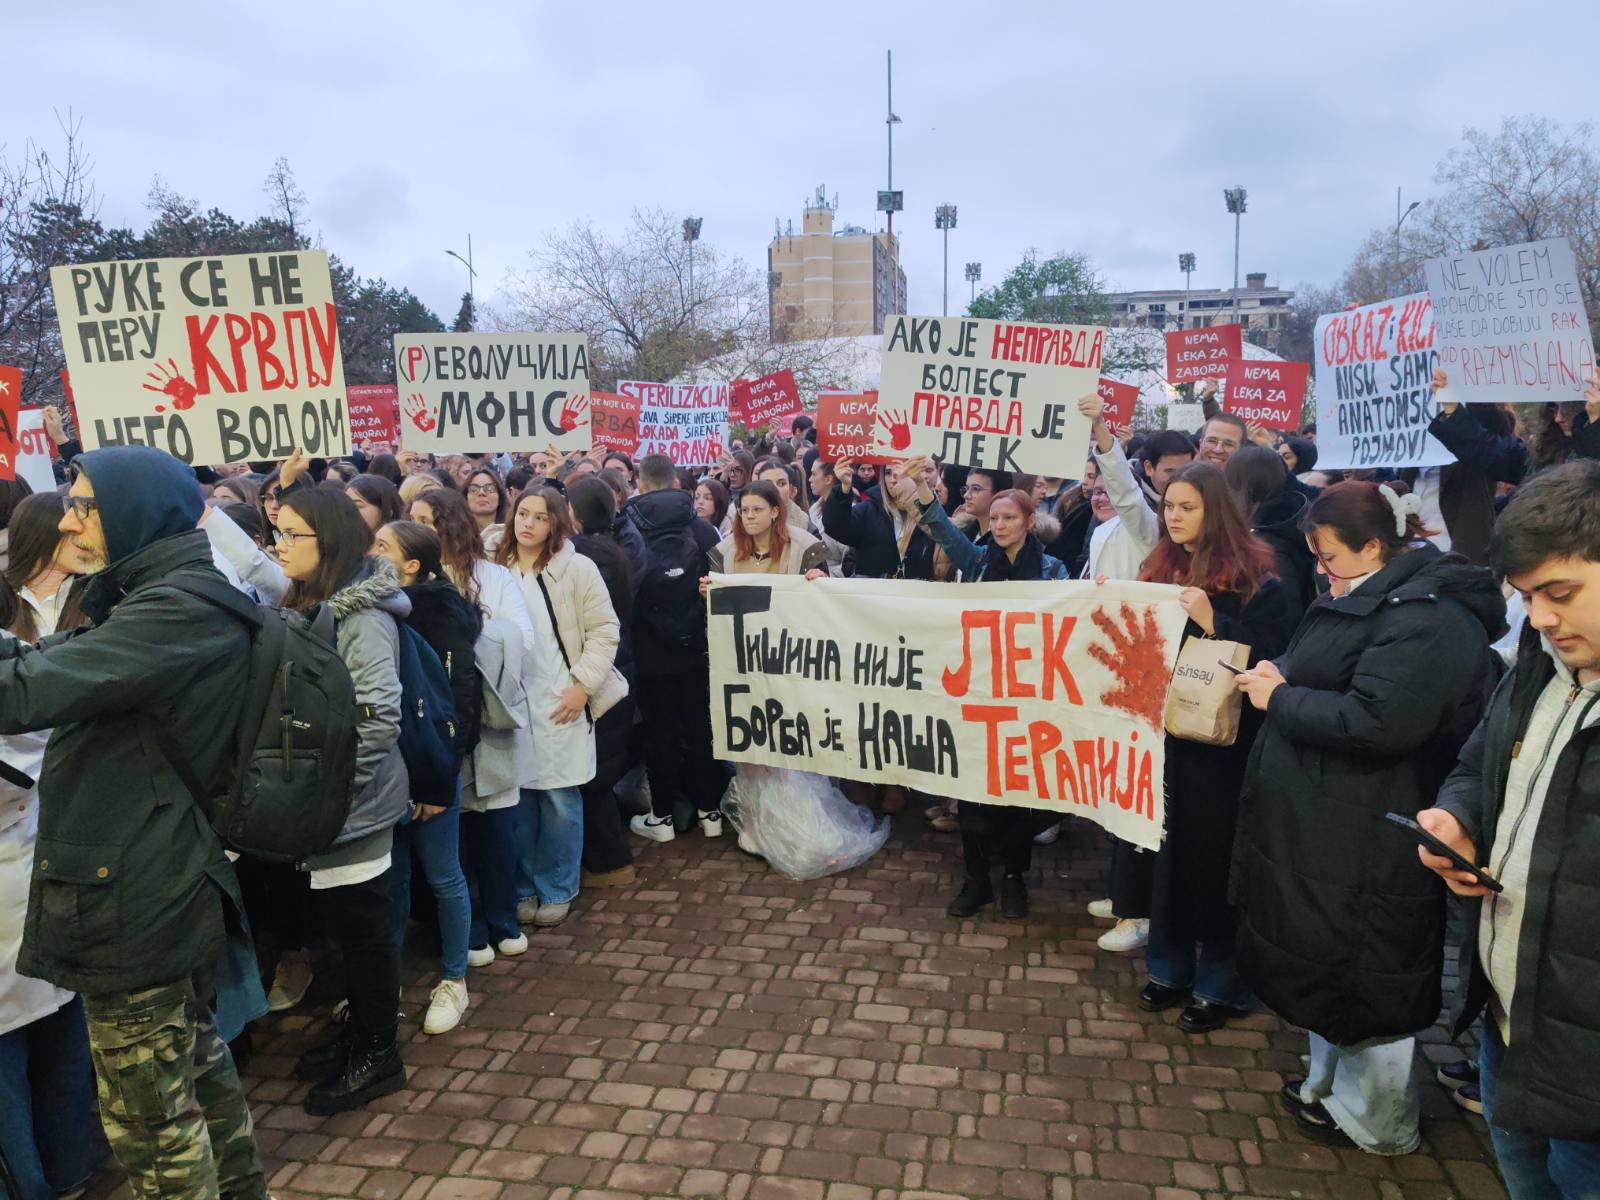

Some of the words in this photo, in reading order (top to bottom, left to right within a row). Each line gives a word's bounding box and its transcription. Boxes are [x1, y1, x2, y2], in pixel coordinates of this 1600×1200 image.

[1440, 259, 1470, 291] NE
[1478, 247, 1553, 287] VOLEM
[71, 261, 165, 315] РУКЕ
[180, 259, 228, 307] СЕ
[249, 255, 303, 306] НЕ
[1554, 283, 1578, 305] SE
[1471, 319, 1489, 337] DA
[1493, 315, 1542, 336] DOBIJU
[1551, 312, 1581, 331] RAK
[888, 317, 941, 354] АКО
[948, 321, 979, 357] ЈЕ
[991, 324, 1102, 369] НЕПРАВДА
[1185, 332, 1219, 345] NEMA
[1323, 304, 1394, 368] OBRAZ
[77, 313, 161, 362] ПЕРУ
[185, 302, 337, 395] КРВЉУ
[1177, 350, 1206, 362] LEKA
[1210, 347, 1228, 359] ZA
[399, 344, 589, 383] (Р)ЕВОЛУЦИЈА
[1176, 363, 1229, 378] ZABORA
[1244, 367, 1281, 381] NEMA
[750, 379, 776, 395] NEMA
[922, 363, 1026, 398] БОЛЕСТ
[1336, 362, 1378, 400] NISU
[746, 396, 771, 410] LEKA
[773, 390, 787, 401] ZA
[1232, 386, 1262, 400] LEKA
[1266, 388, 1286, 402] ZA
[437, 390, 568, 438] МФНС
[621, 402, 635, 410] LEK
[750, 400, 794, 424] ZABORAV
[912, 392, 1022, 436] ПРАВДА
[1032, 404, 1065, 440] ЈЕ
[1103, 402, 1118, 415] ZA
[1230, 406, 1291, 424] ZABORAV
[216, 398, 347, 463] ВОДОМ
[351, 418, 366, 427] EKA
[368, 417, 381, 425] ZA
[829, 423, 863, 436] LEKA
[351, 428, 388, 439] ABORAV
[596, 434, 633, 447] TERAPIJA
[827, 443, 878, 457] ZABOR
[931, 431, 1023, 474] ЛЕК
[1350, 428, 1427, 465] POJMOVI
[940, 609, 1084, 706] ЛЕК
[1177, 664, 1214, 686] sinsay
